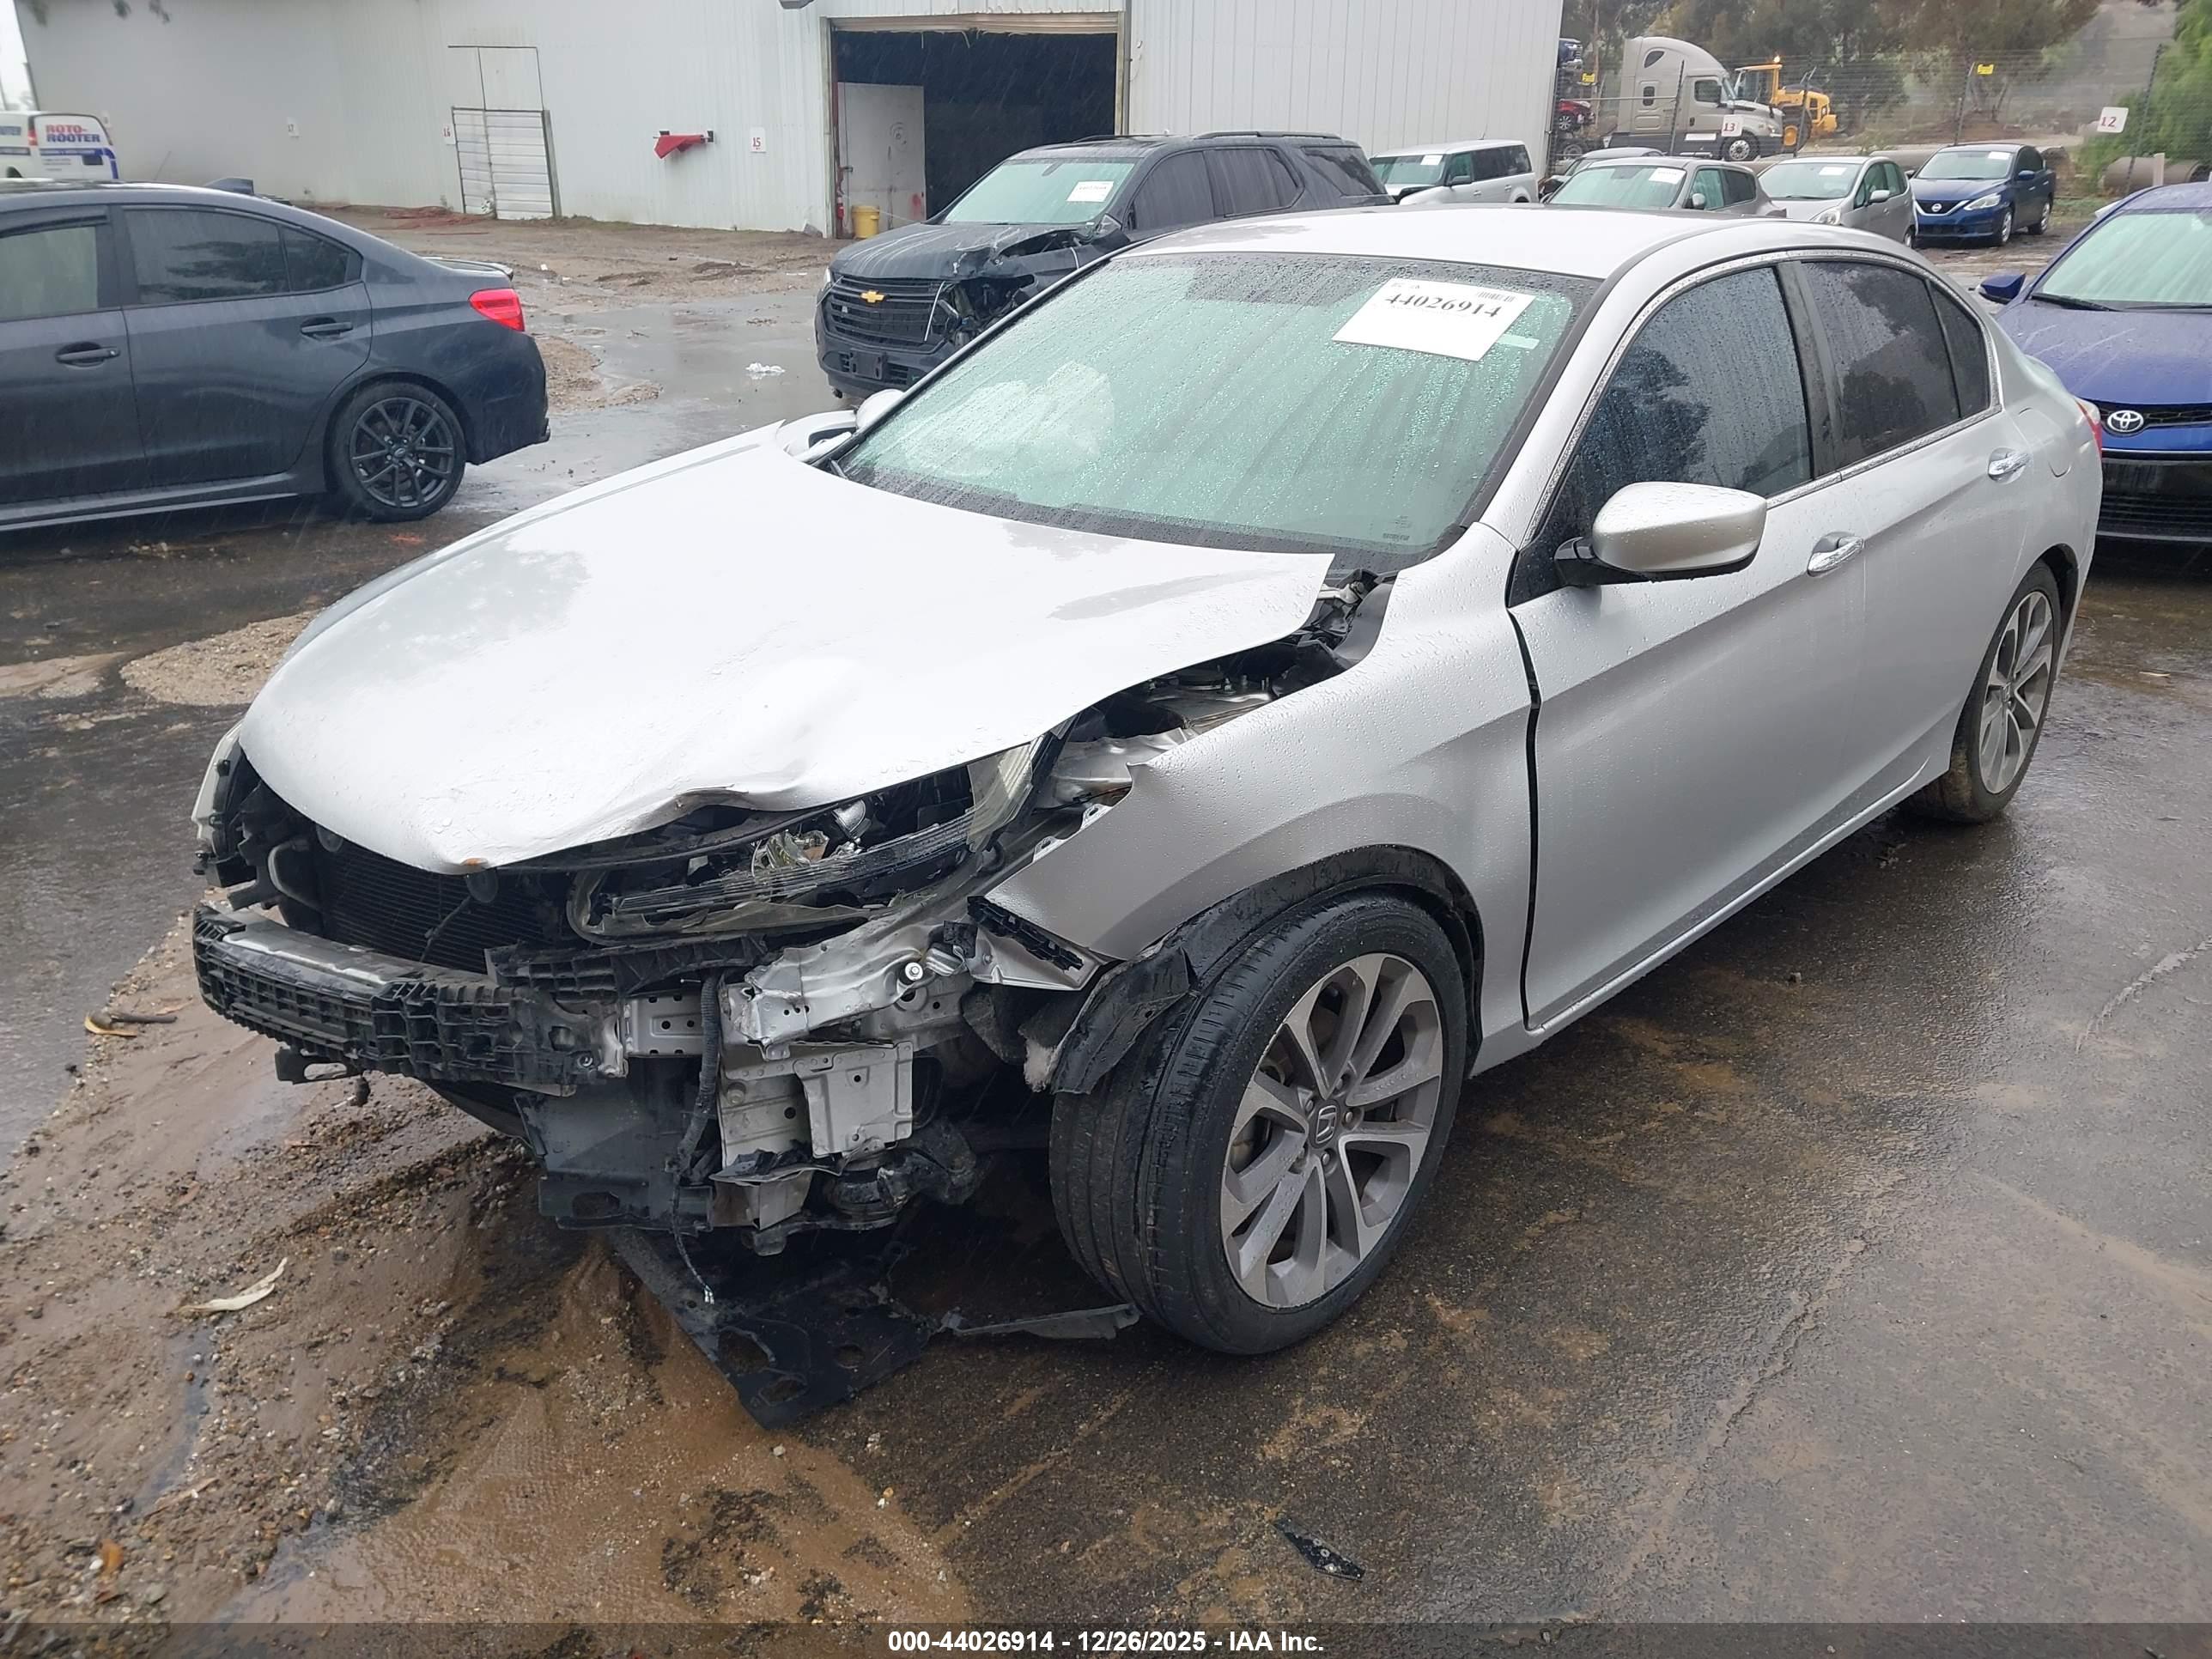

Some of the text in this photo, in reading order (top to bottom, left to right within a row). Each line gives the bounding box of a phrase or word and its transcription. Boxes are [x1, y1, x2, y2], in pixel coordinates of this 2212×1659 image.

[2101, 116, 2117, 127] 12
[46, 125, 88, 133] ROTO-
[1723, 123, 1735, 131] 13
[46, 134, 100, 143] ROOTER
[752, 137, 761, 147] 15
[1386, 294, 1501, 317] 44026914
